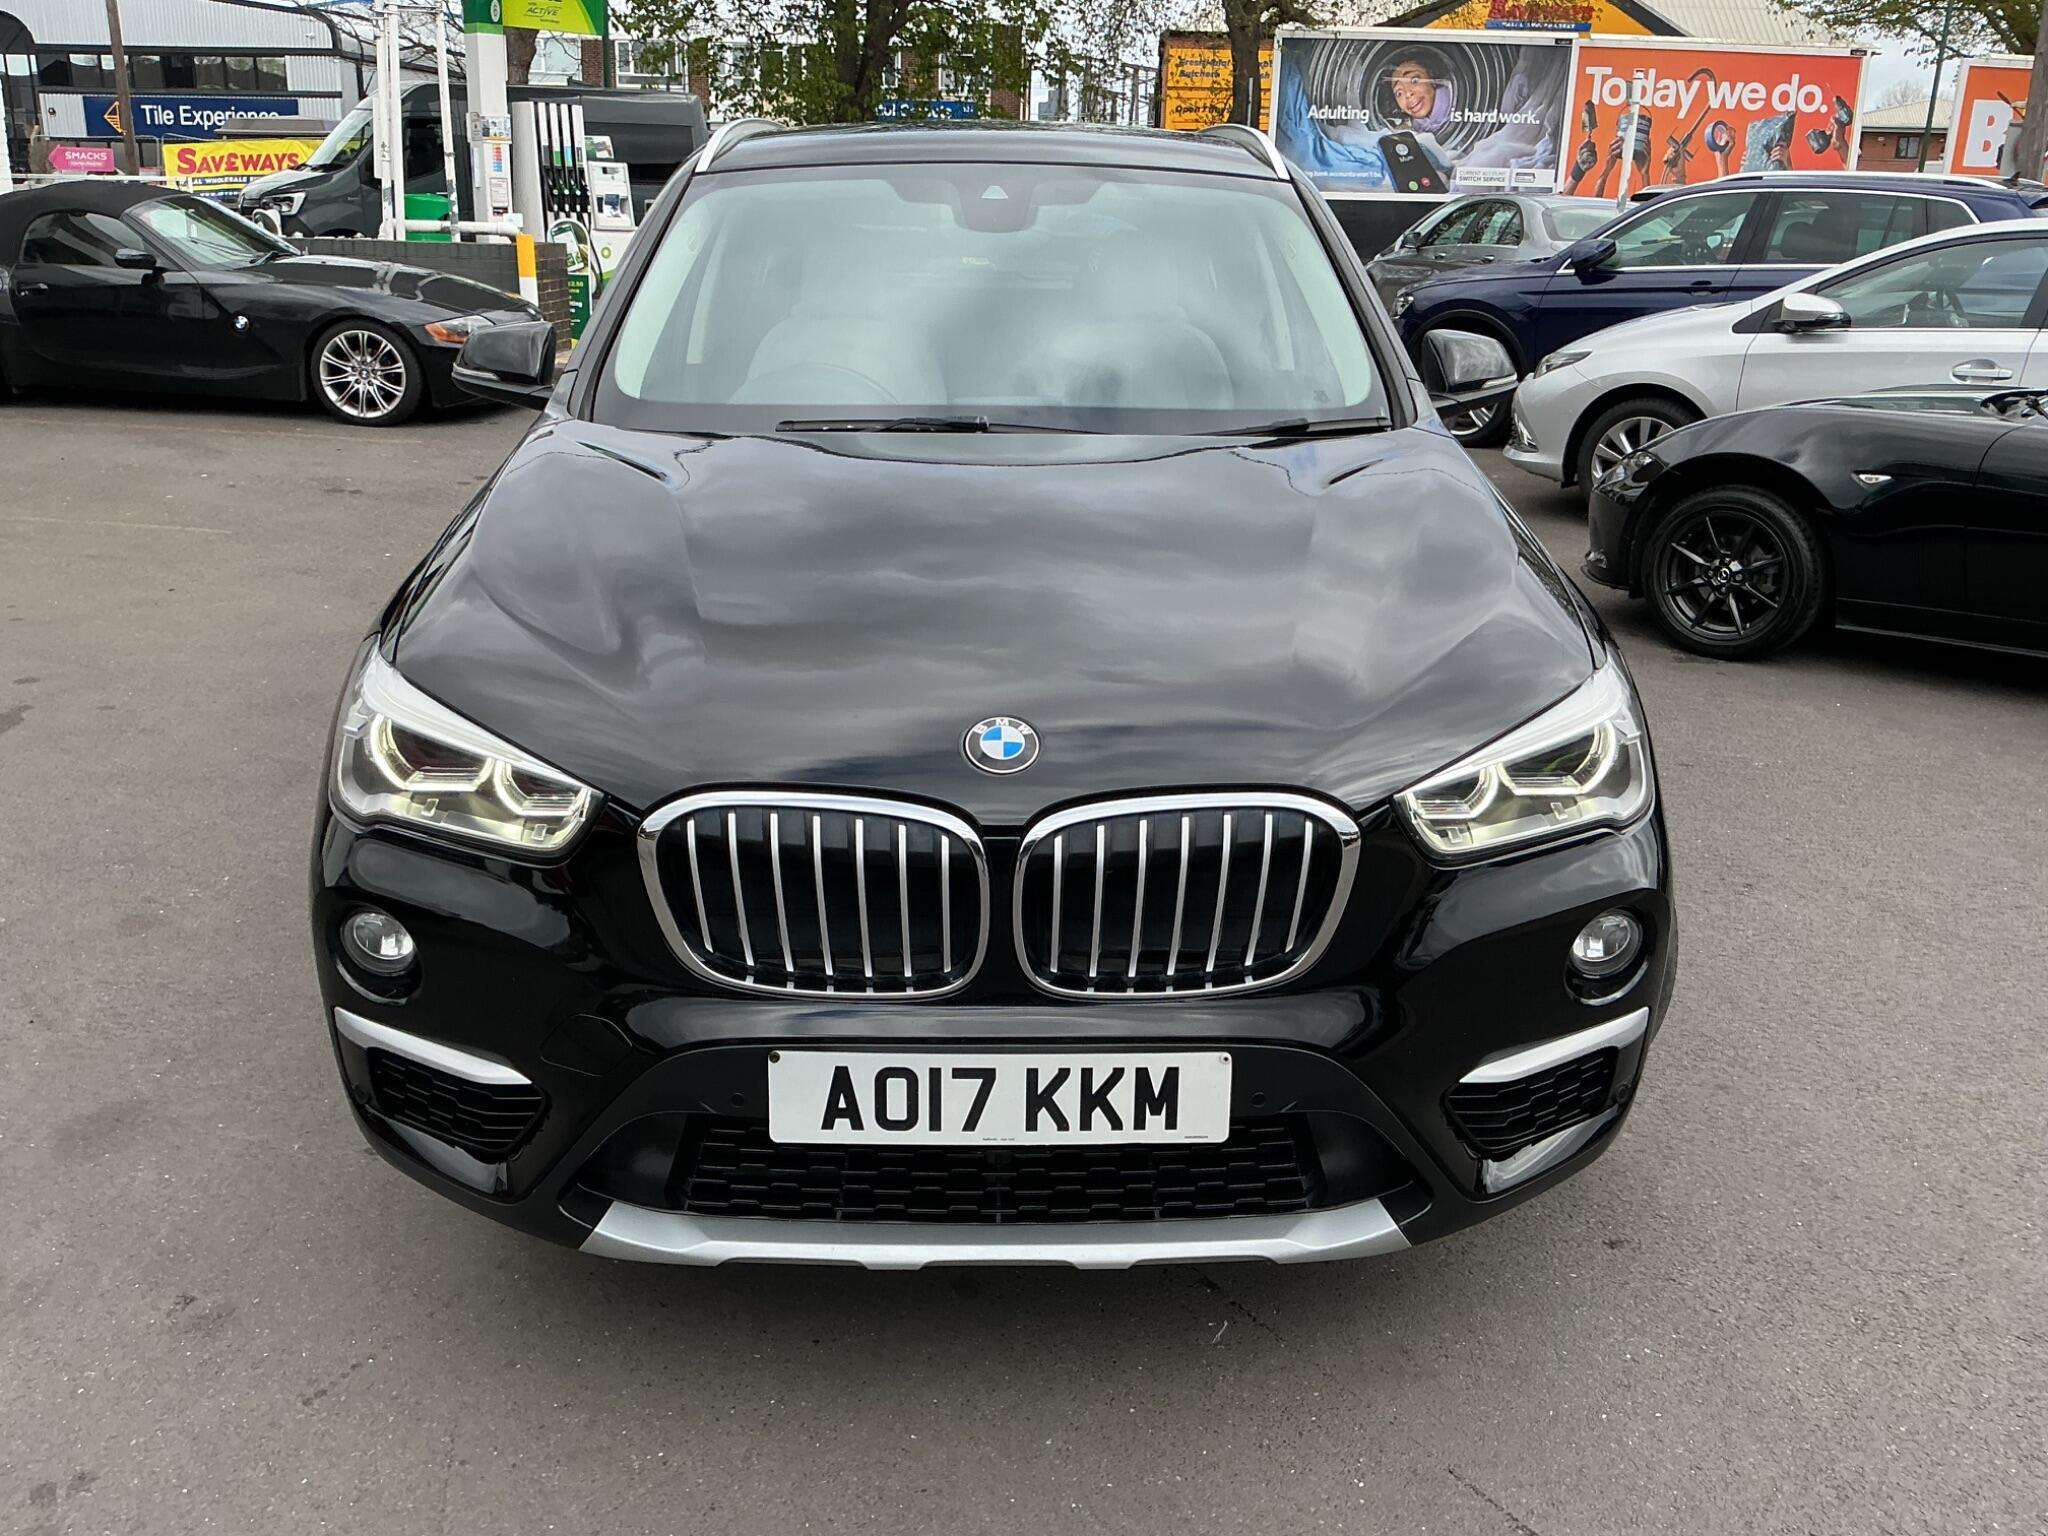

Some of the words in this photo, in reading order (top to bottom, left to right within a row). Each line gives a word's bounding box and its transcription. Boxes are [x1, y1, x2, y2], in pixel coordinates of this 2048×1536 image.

[526, 6, 560, 16] ACTIVE
[1585, 66, 1701, 119] Today
[1707, 80, 1767, 111] we
[1772, 74, 1828, 114] do.
[140, 104, 175, 125] Tile
[1307, 104, 1370, 124] Adulting
[1450, 107, 1462, 122] is
[1464, 108, 1498, 123] hard
[1499, 109, 1540, 124] work.
[65, 151, 107, 160] SMACKS
[819, 1065, 998, 1132] AO17
[1024, 1066, 1181, 1132] KKM
